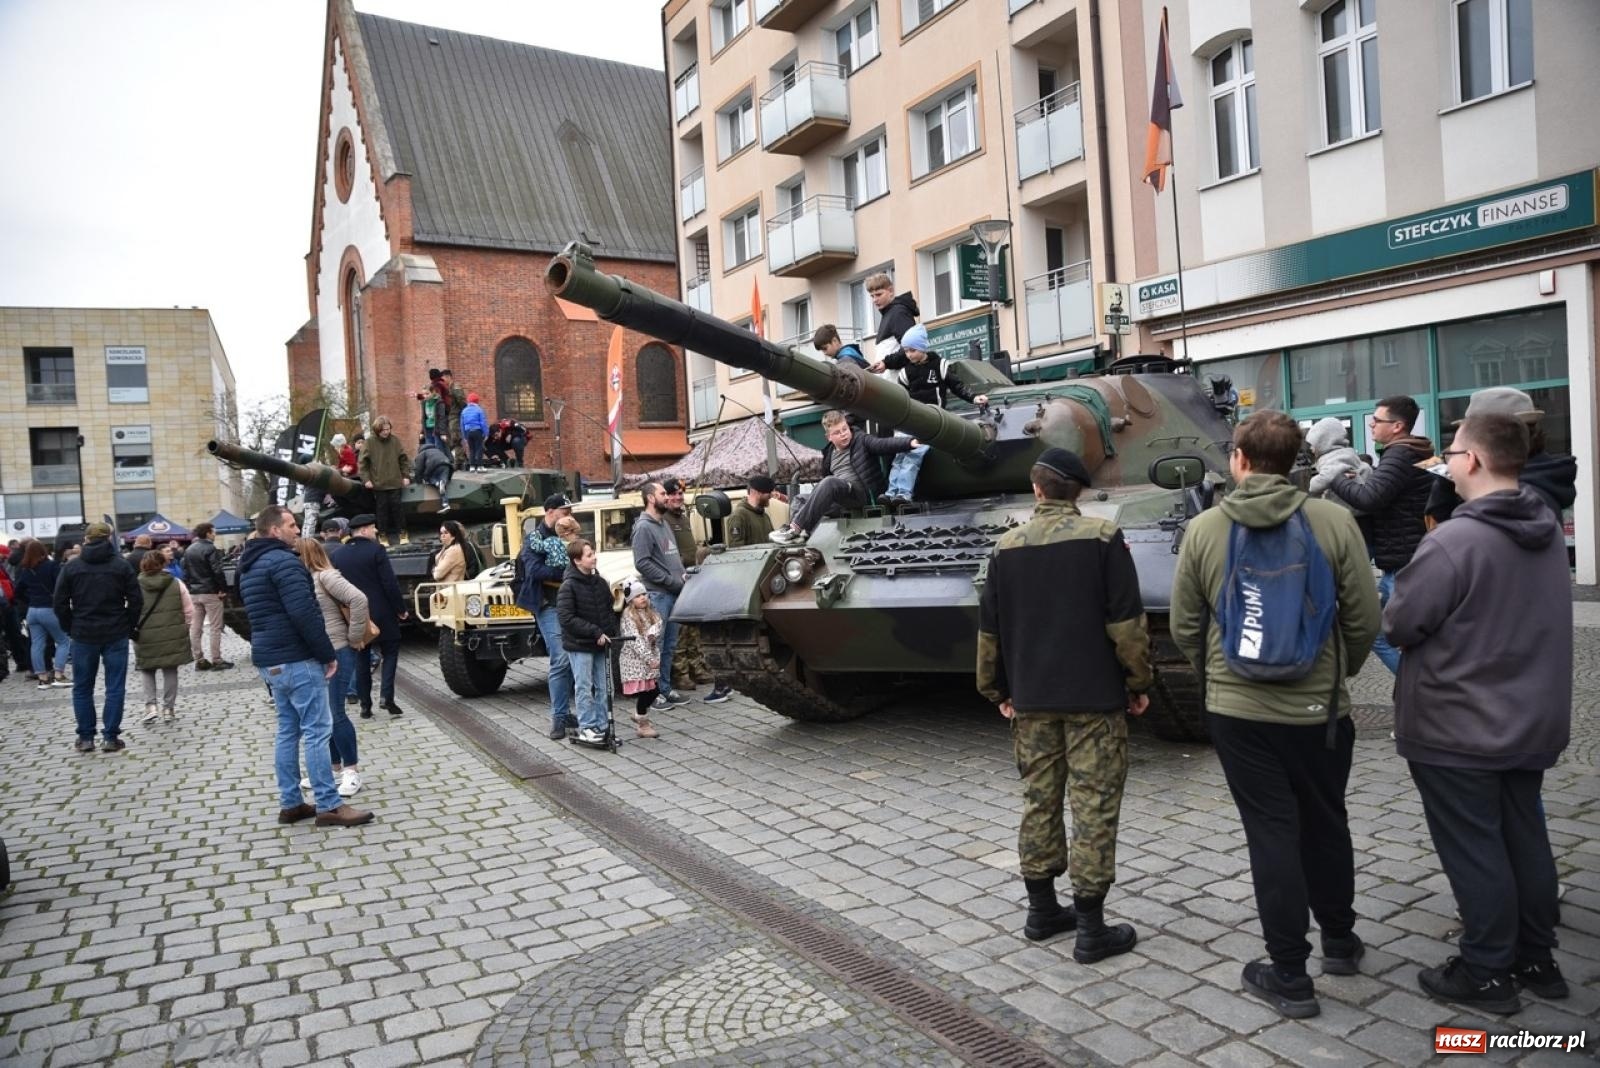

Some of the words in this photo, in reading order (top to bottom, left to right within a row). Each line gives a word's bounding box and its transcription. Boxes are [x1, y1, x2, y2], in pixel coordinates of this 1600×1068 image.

[1394, 213, 1472, 242] STEFCZYK
[1482, 192, 1559, 223] FINANSE
[1151, 282, 1176, 296] KASA
